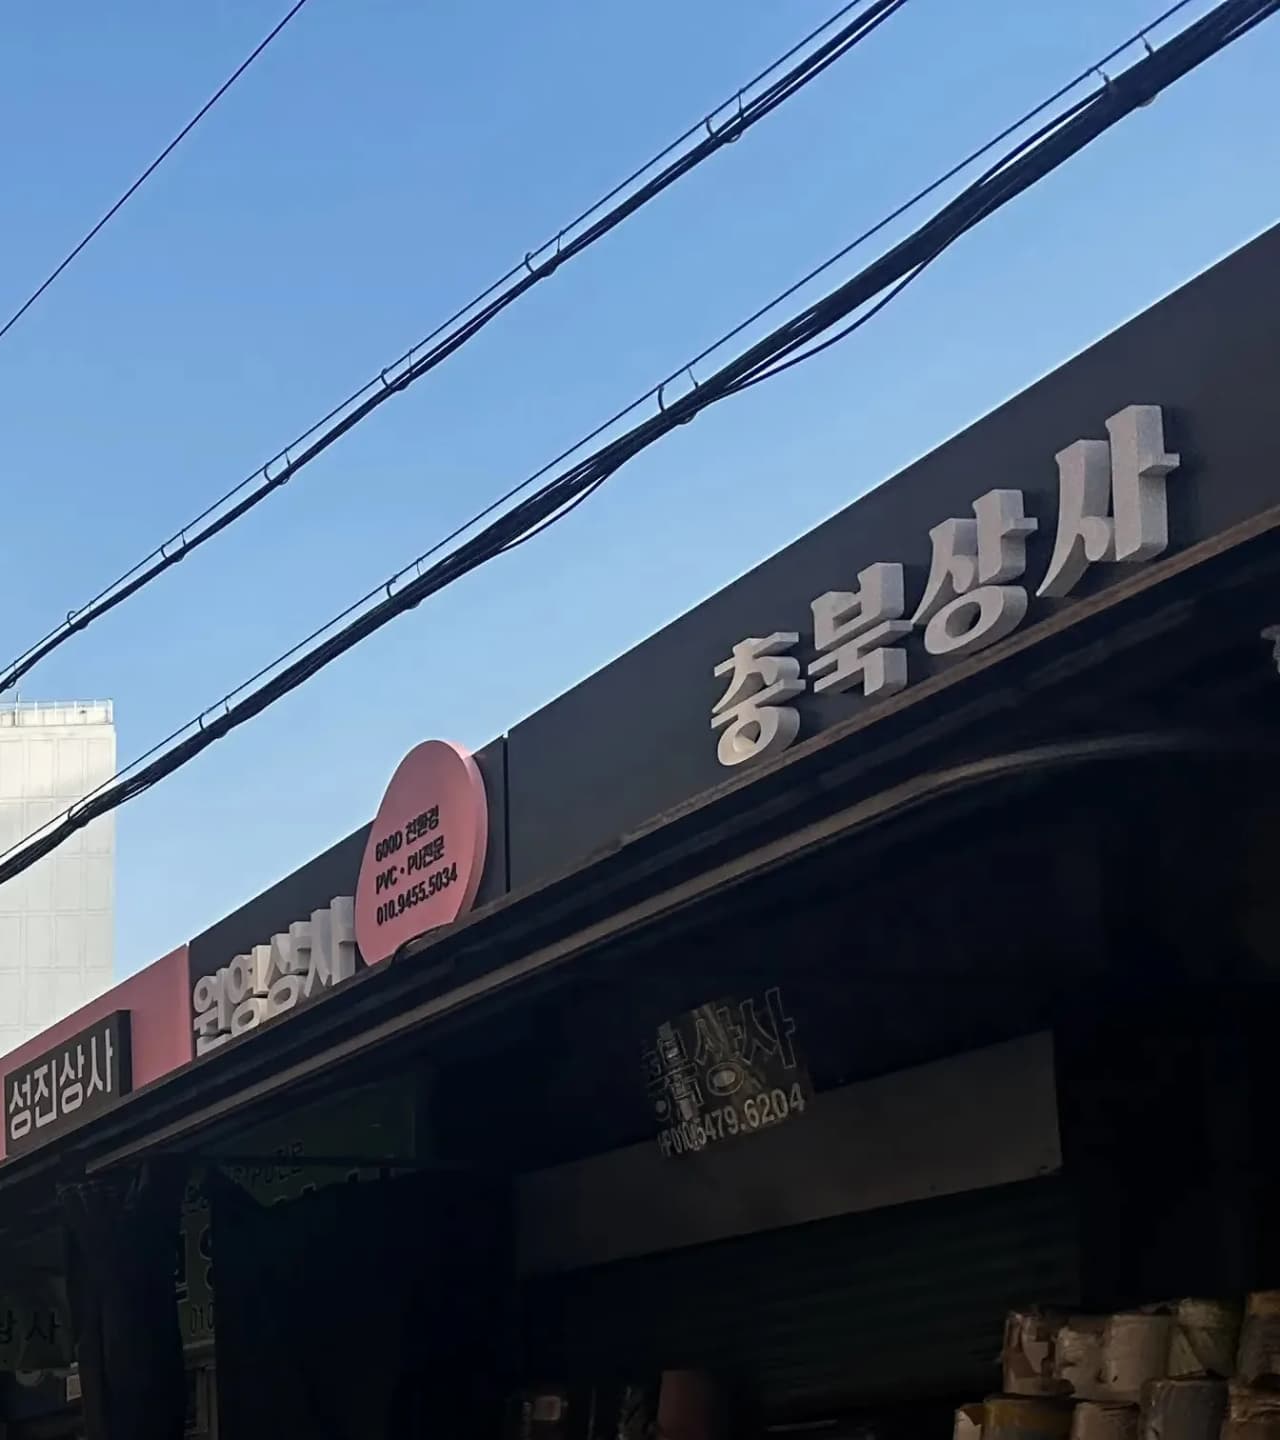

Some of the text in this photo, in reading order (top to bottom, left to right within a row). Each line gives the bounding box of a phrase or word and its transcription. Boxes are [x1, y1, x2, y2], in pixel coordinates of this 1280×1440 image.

[710, 404, 1180, 766] 충북상사
[376, 866, 397, 894] PVC
[377, 862, 458, 926] 010.9455.5034
[192, 896, 357, 1057] 원영상사
[9, 1029, 113, 1141] 성진상사
